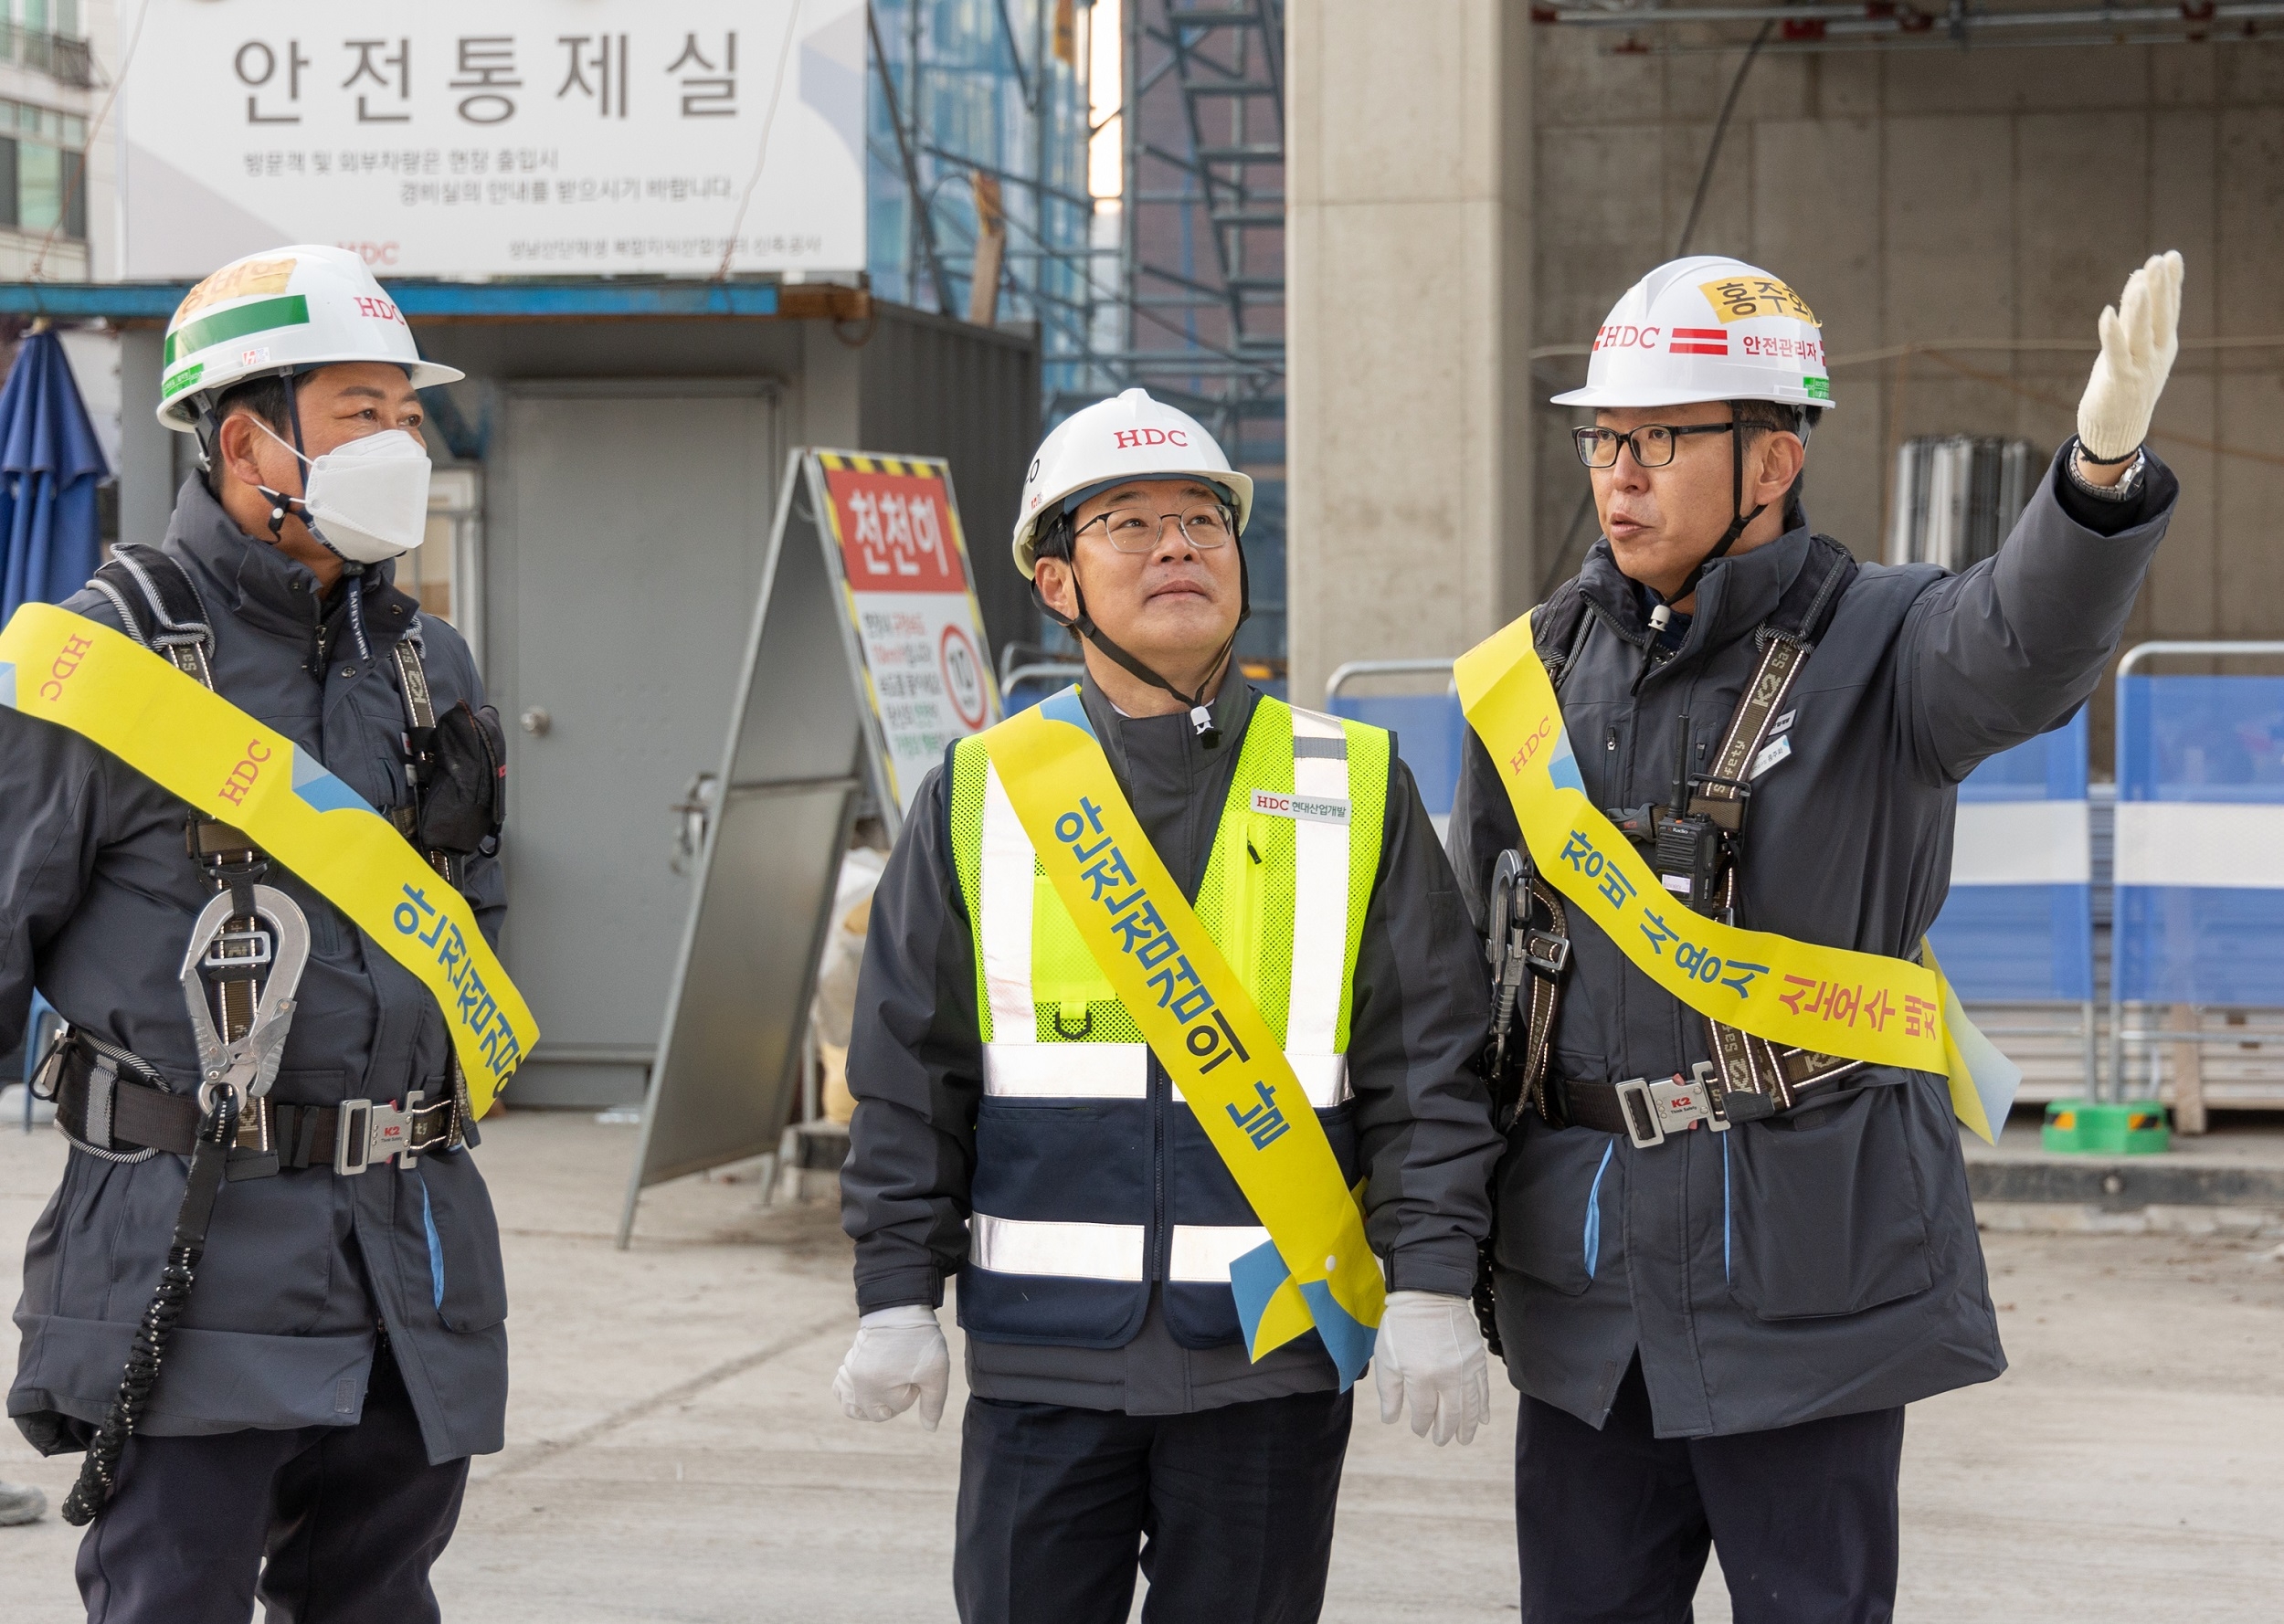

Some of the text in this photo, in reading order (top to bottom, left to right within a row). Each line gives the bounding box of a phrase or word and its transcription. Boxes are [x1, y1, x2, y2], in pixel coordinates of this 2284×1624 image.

[234, 29, 739, 125] 안전통제실
[335, 241, 399, 266] DC
[353, 297, 405, 326] HDC
[1602, 325, 1660, 350] HDC
[1743, 335, 1816, 362] 안전관리자
[1114, 428, 1189, 449] HDC
[848, 489, 949, 578] 천천히
[39, 633, 93, 702] HDC
[1509, 715, 1551, 776] HDC
[218, 738, 272, 807] HDC
[1257, 796, 1347, 817] HDC 현대산업개발
[1560, 828, 1638, 911] 장비
[1639, 906, 1771, 1000] 사용시
[1778, 974, 1897, 1034] 신호수
[1054, 796, 1291, 1151] 안전점검의 날
[1671, 1097, 1691, 1108] K2
[384, 1125, 400, 1137] K2
